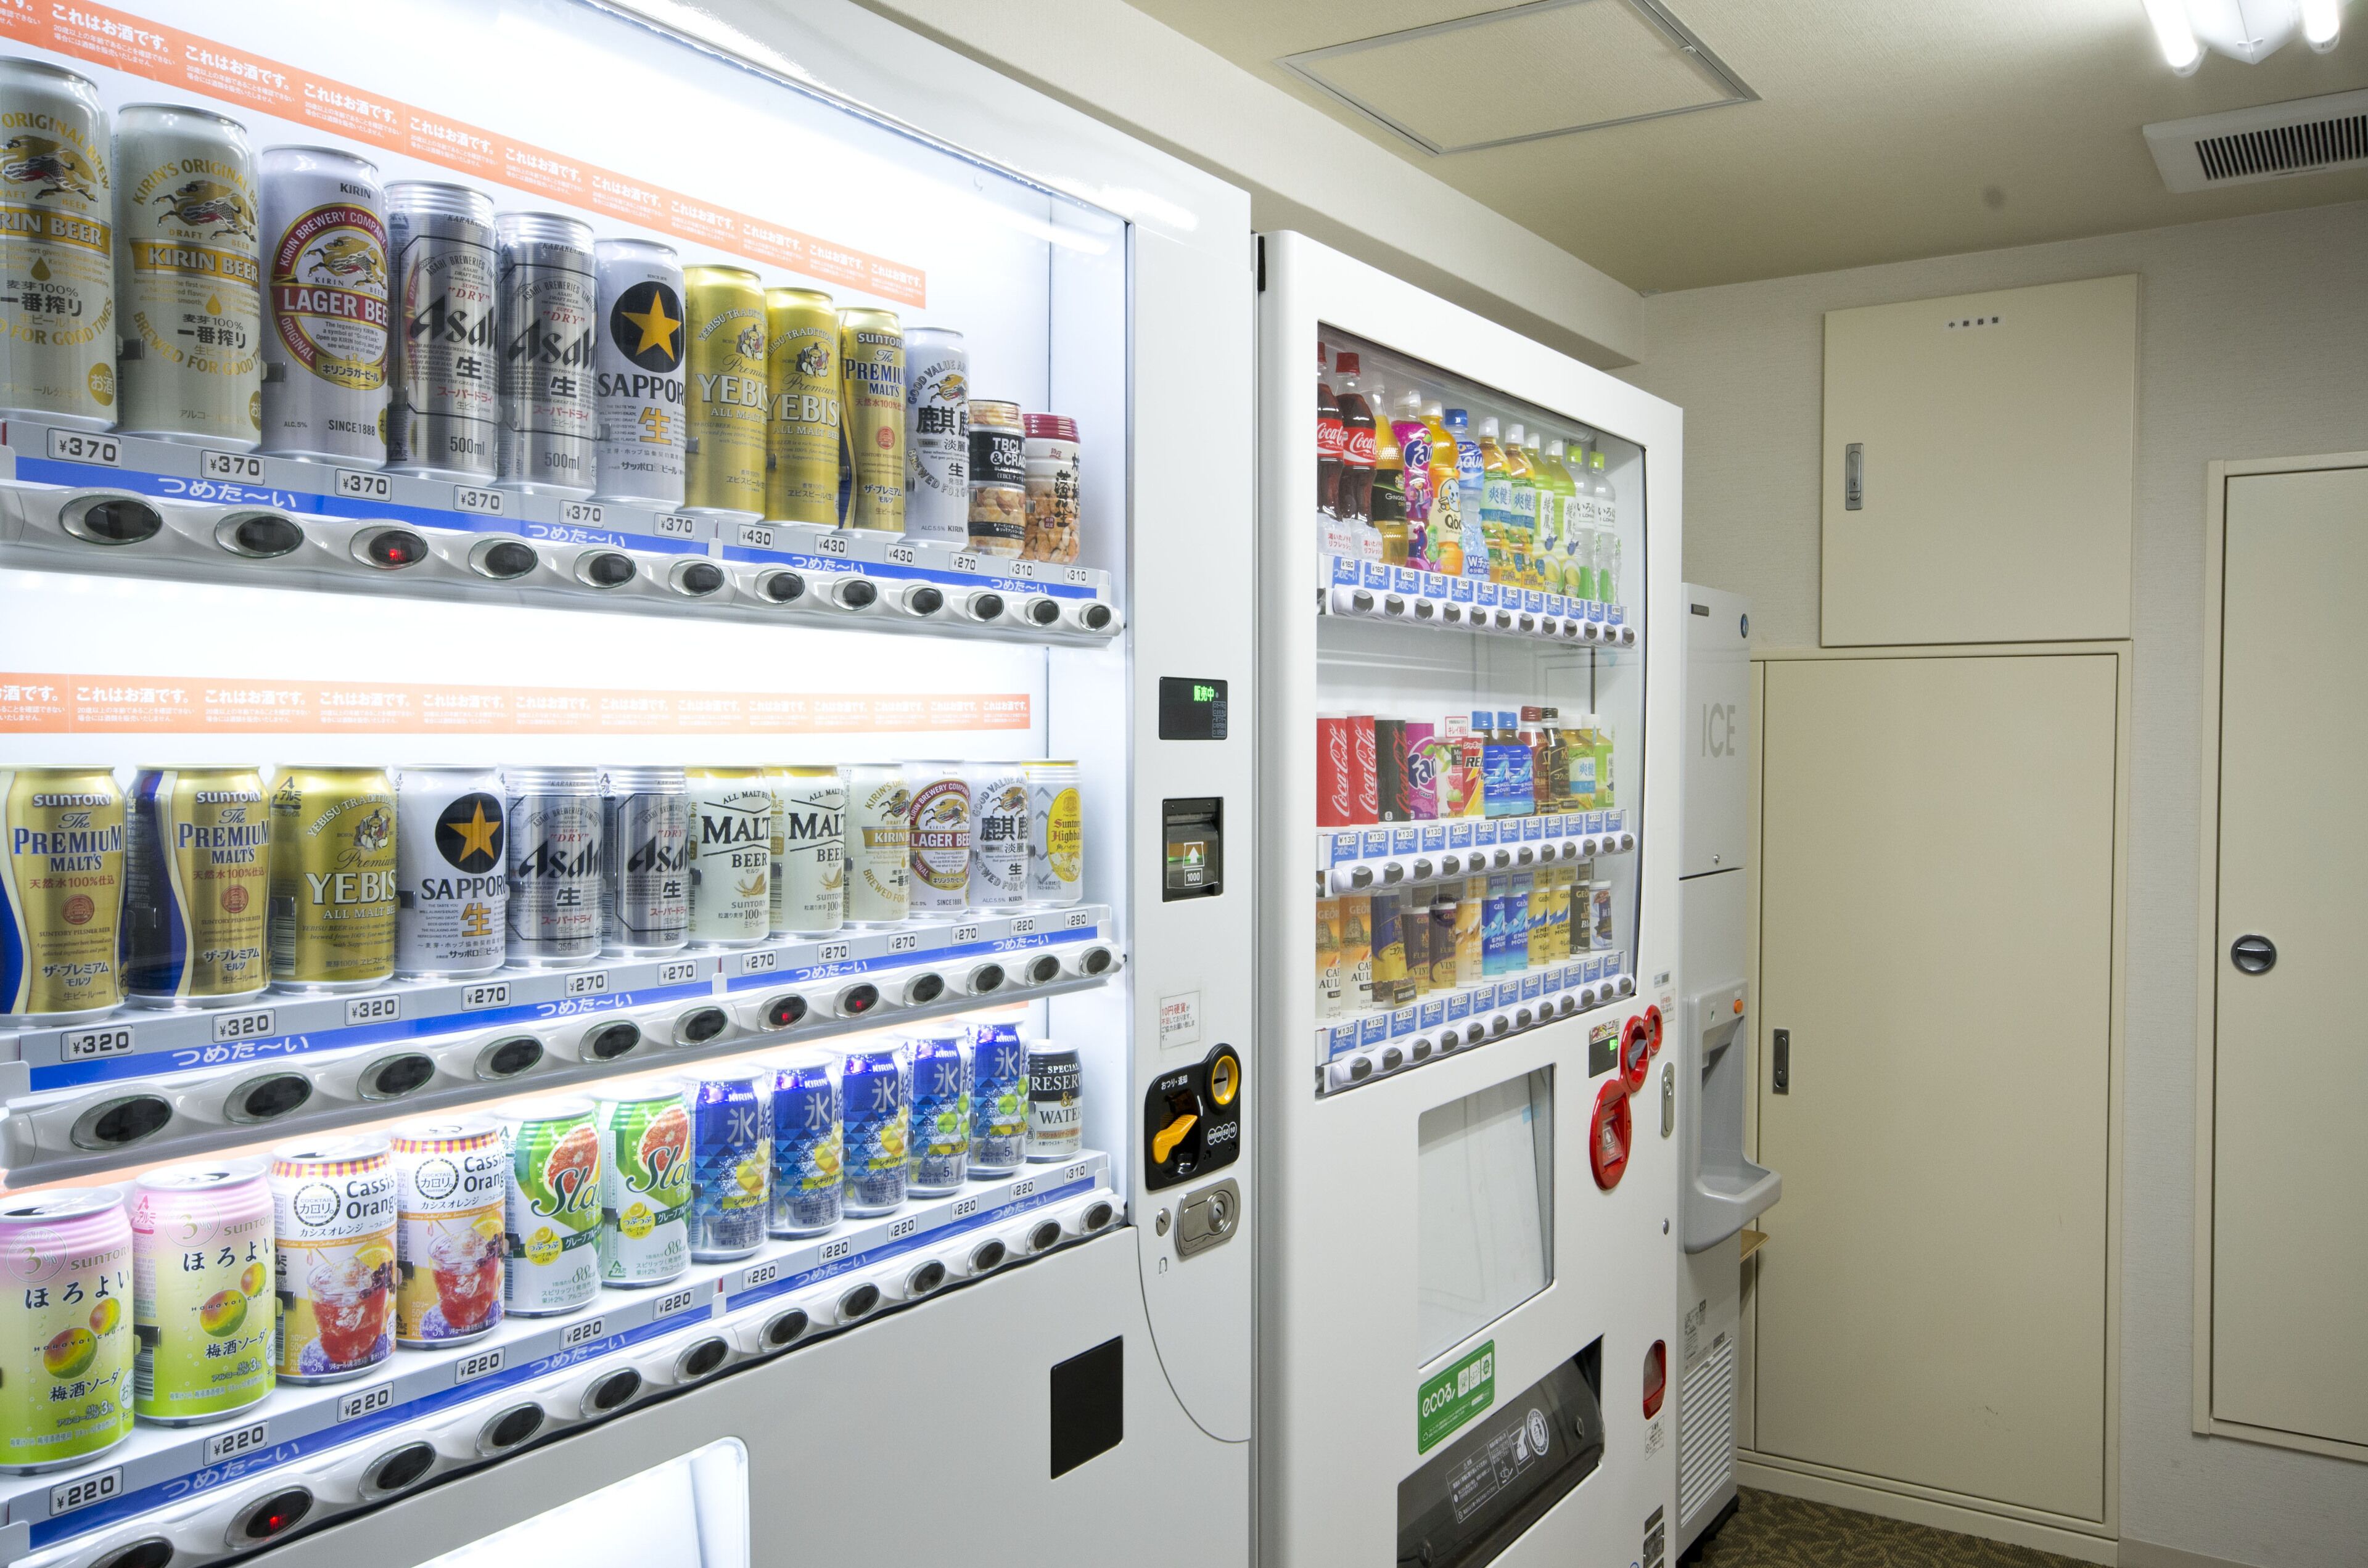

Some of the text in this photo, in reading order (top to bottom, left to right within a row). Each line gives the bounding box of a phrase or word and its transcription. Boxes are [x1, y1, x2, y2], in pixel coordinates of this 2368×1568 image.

[52, 2, 168, 53] これはお酒です。
[185, 44, 290, 91] これはお酒です。
[304, 81, 397, 123] これはお酒です。
[410, 117, 493, 154] これはお酒です。
[133, 158, 247, 205] KIRIN'S ORIGINAL
[340, 183, 371, 199] KIRIN
[51, 218, 102, 247] BEER
[296, 211, 345, 239] BREWERY
[169, 229, 202, 240] DRAFT
[148, 247, 258, 283] KIRIN BEER
[450, 255, 485, 269] BREWERIES
[6, 280, 79, 297] 麦芽100%
[315, 277, 344, 286] KIRIN
[545, 281, 579, 294] BREWERIES
[1, 292, 82, 317] 一番搾り
[284, 289, 356, 316] LAGER
[364, 297, 388, 325] BEE
[10, 326, 47, 345] FOR
[52, 327, 95, 345] GOOD
[95, 297, 112, 334] TIMES
[183, 314, 243, 331] 麦芽100%
[698, 315, 726, 341] YEBISU
[133, 311, 218, 374] BREWED FOR
[178, 326, 246, 349] 一番搾り
[281, 318, 313, 361] ORIGINAL
[874, 350, 894, 363] The
[323, 364, 379, 382] キリンラガービール
[456, 357, 482, 380] 生
[598, 373, 685, 405] SAPPOR
[869, 384, 900, 398] MALT'S
[908, 360, 956, 405] GOOD VALUE
[438, 387, 493, 404] スーパードライ
[696, 374, 767, 412] YEBIS
[533, 405, 588, 420] スーパードライ
[711, 408, 760, 421] ALL MALT
[329, 419, 375, 435] SINCE 1888
[638, 406, 672, 445] 生
[59, 437, 117, 462] ¥370
[450, 437, 485, 456] 500ml
[992, 437, 1020, 453] TBCL
[210, 455, 260, 476] ¥370
[545, 453, 579, 470] 500ml
[907, 448, 939, 491] BREWED
[343, 475, 387, 494] ¥370
[864, 485, 902, 497] ザ・プレミアム
[461, 491, 500, 510] ¥370
[566, 506, 601, 522] ¥370
[660, 518, 693, 533] ¥370
[742, 532, 771, 546] ¥430
[818, 541, 845, 553] ¥430
[889, 550, 913, 562] ¥430
[953, 558, 976, 570] ¥270
[1011, 564, 1032, 577] ¥310
[1067, 571, 1086, 582] ¥310
[1194, 685, 1214, 702] 販売中
[1702, 703, 1735, 758] ICE
[33, 794, 112, 807] SUNTORY
[196, 790, 261, 803] SUNTORY
[919, 784, 947, 803] BREWERY
[58, 811, 91, 828] The
[307, 805, 340, 837] YEBISU
[13, 825, 122, 854] PREMIUM
[178, 820, 270, 848] PREMIUM
[911, 834, 952, 847] LAGER
[50, 854, 102, 872] MALT'S
[212, 847, 255, 864] MALT'S
[731, 853, 767, 868] BEER
[29, 876, 114, 889] 天然水100%仕込
[1187, 872, 1200, 882] 1000
[556, 887, 581, 906] 生
[663, 880, 681, 899] 生
[731, 900, 766, 909] SUNTORY
[323, 908, 384, 919] ALL MALT
[461, 902, 492, 937] 生
[541, 914, 592, 925] スーパードライ
[1067, 914, 1086, 926] ¥290
[1013, 920, 1033, 931] ¥220
[204, 948, 259, 962] ザ・プレミアム
[558, 942, 579, 951] 350ml
[42, 962, 109, 978] ザ・プレミアム
[746, 955, 774, 968] ¥270
[663, 965, 693, 980] ¥270
[65, 976, 91, 987] モルツ
[570, 975, 604, 991] ¥270
[467, 987, 505, 1004] ¥270
[352, 999, 394, 1017] ¥320
[1397, 1010, 1412, 1019] ¥130
[220, 1015, 268, 1036] ¥320
[1338, 1027, 1353, 1035] ¥130
[1368, 1019, 1383, 1027] ¥130
[73, 1032, 129, 1054] ¥320
[1048, 1062, 1079, 1073] SPECIAL
[728, 1093, 754, 1102] KIRIN
[464, 1152, 504, 1173] Cassis
[1066, 1166, 1085, 1179] ¥310
[346, 1173, 395, 1198] Cassis
[421, 1196, 480, 1210] カシスオレンジ
[623, 1217, 652, 1225] つぶつぶ
[300, 1223, 363, 1238] カシスオレンジ
[184, 1238, 273, 1271] ほろよい
[528, 1242, 560, 1251] つぶつぶ
[25, 1271, 130, 1309] ほろよい
[192, 1299, 241, 1311] HOROYOI
[659, 1292, 690, 1313] ¥220
[567, 1321, 601, 1343] ¥220
[34, 1338, 90, 1352] HOROYOI
[206, 1327, 265, 1359] 梅酒ソーダ
[461, 1353, 498, 1376] ¥220
[49, 1367, 122, 1402] 梅酒ソーダ
[344, 1390, 388, 1416] ¥220
[214, 1426, 263, 1455] ¥220
[57, 1476, 113, 1508] ¥220
